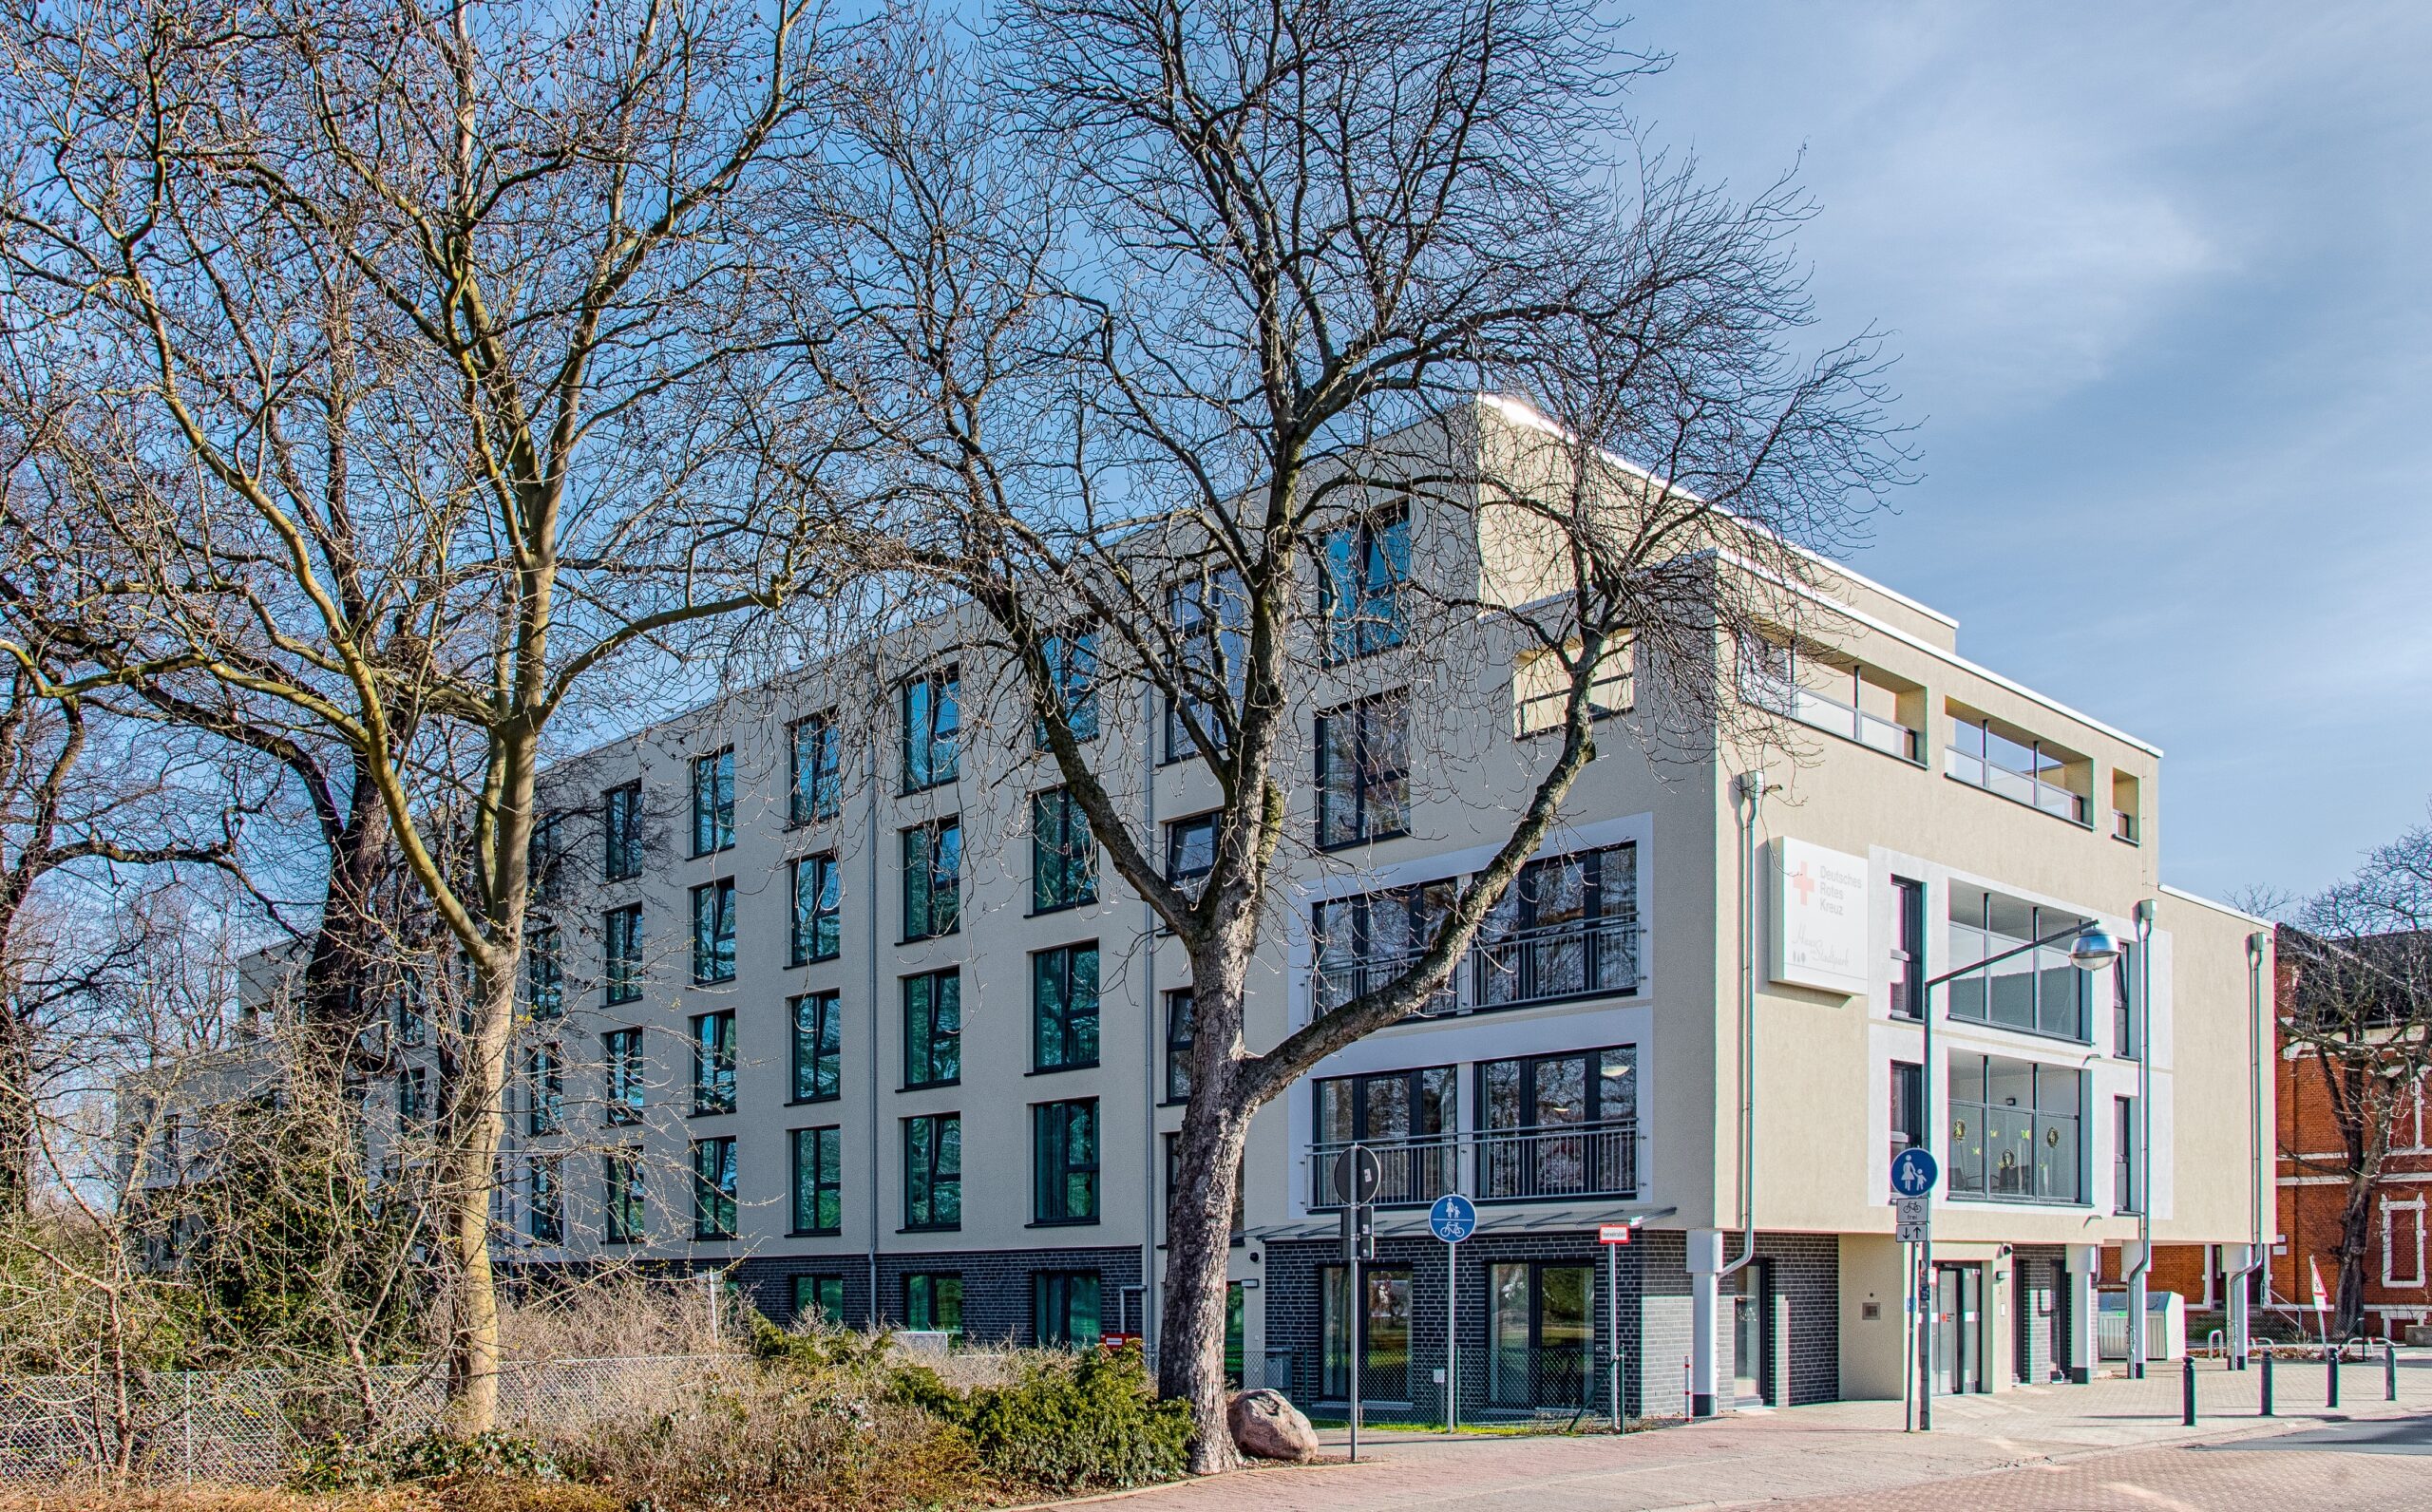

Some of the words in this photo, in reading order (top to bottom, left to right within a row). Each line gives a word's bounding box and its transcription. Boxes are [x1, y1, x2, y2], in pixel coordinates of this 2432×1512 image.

[1819, 865, 1862, 889] Deutsches
[1819, 881, 1844, 899] Rotes
[1819, 898, 1844, 916] Kreuz
